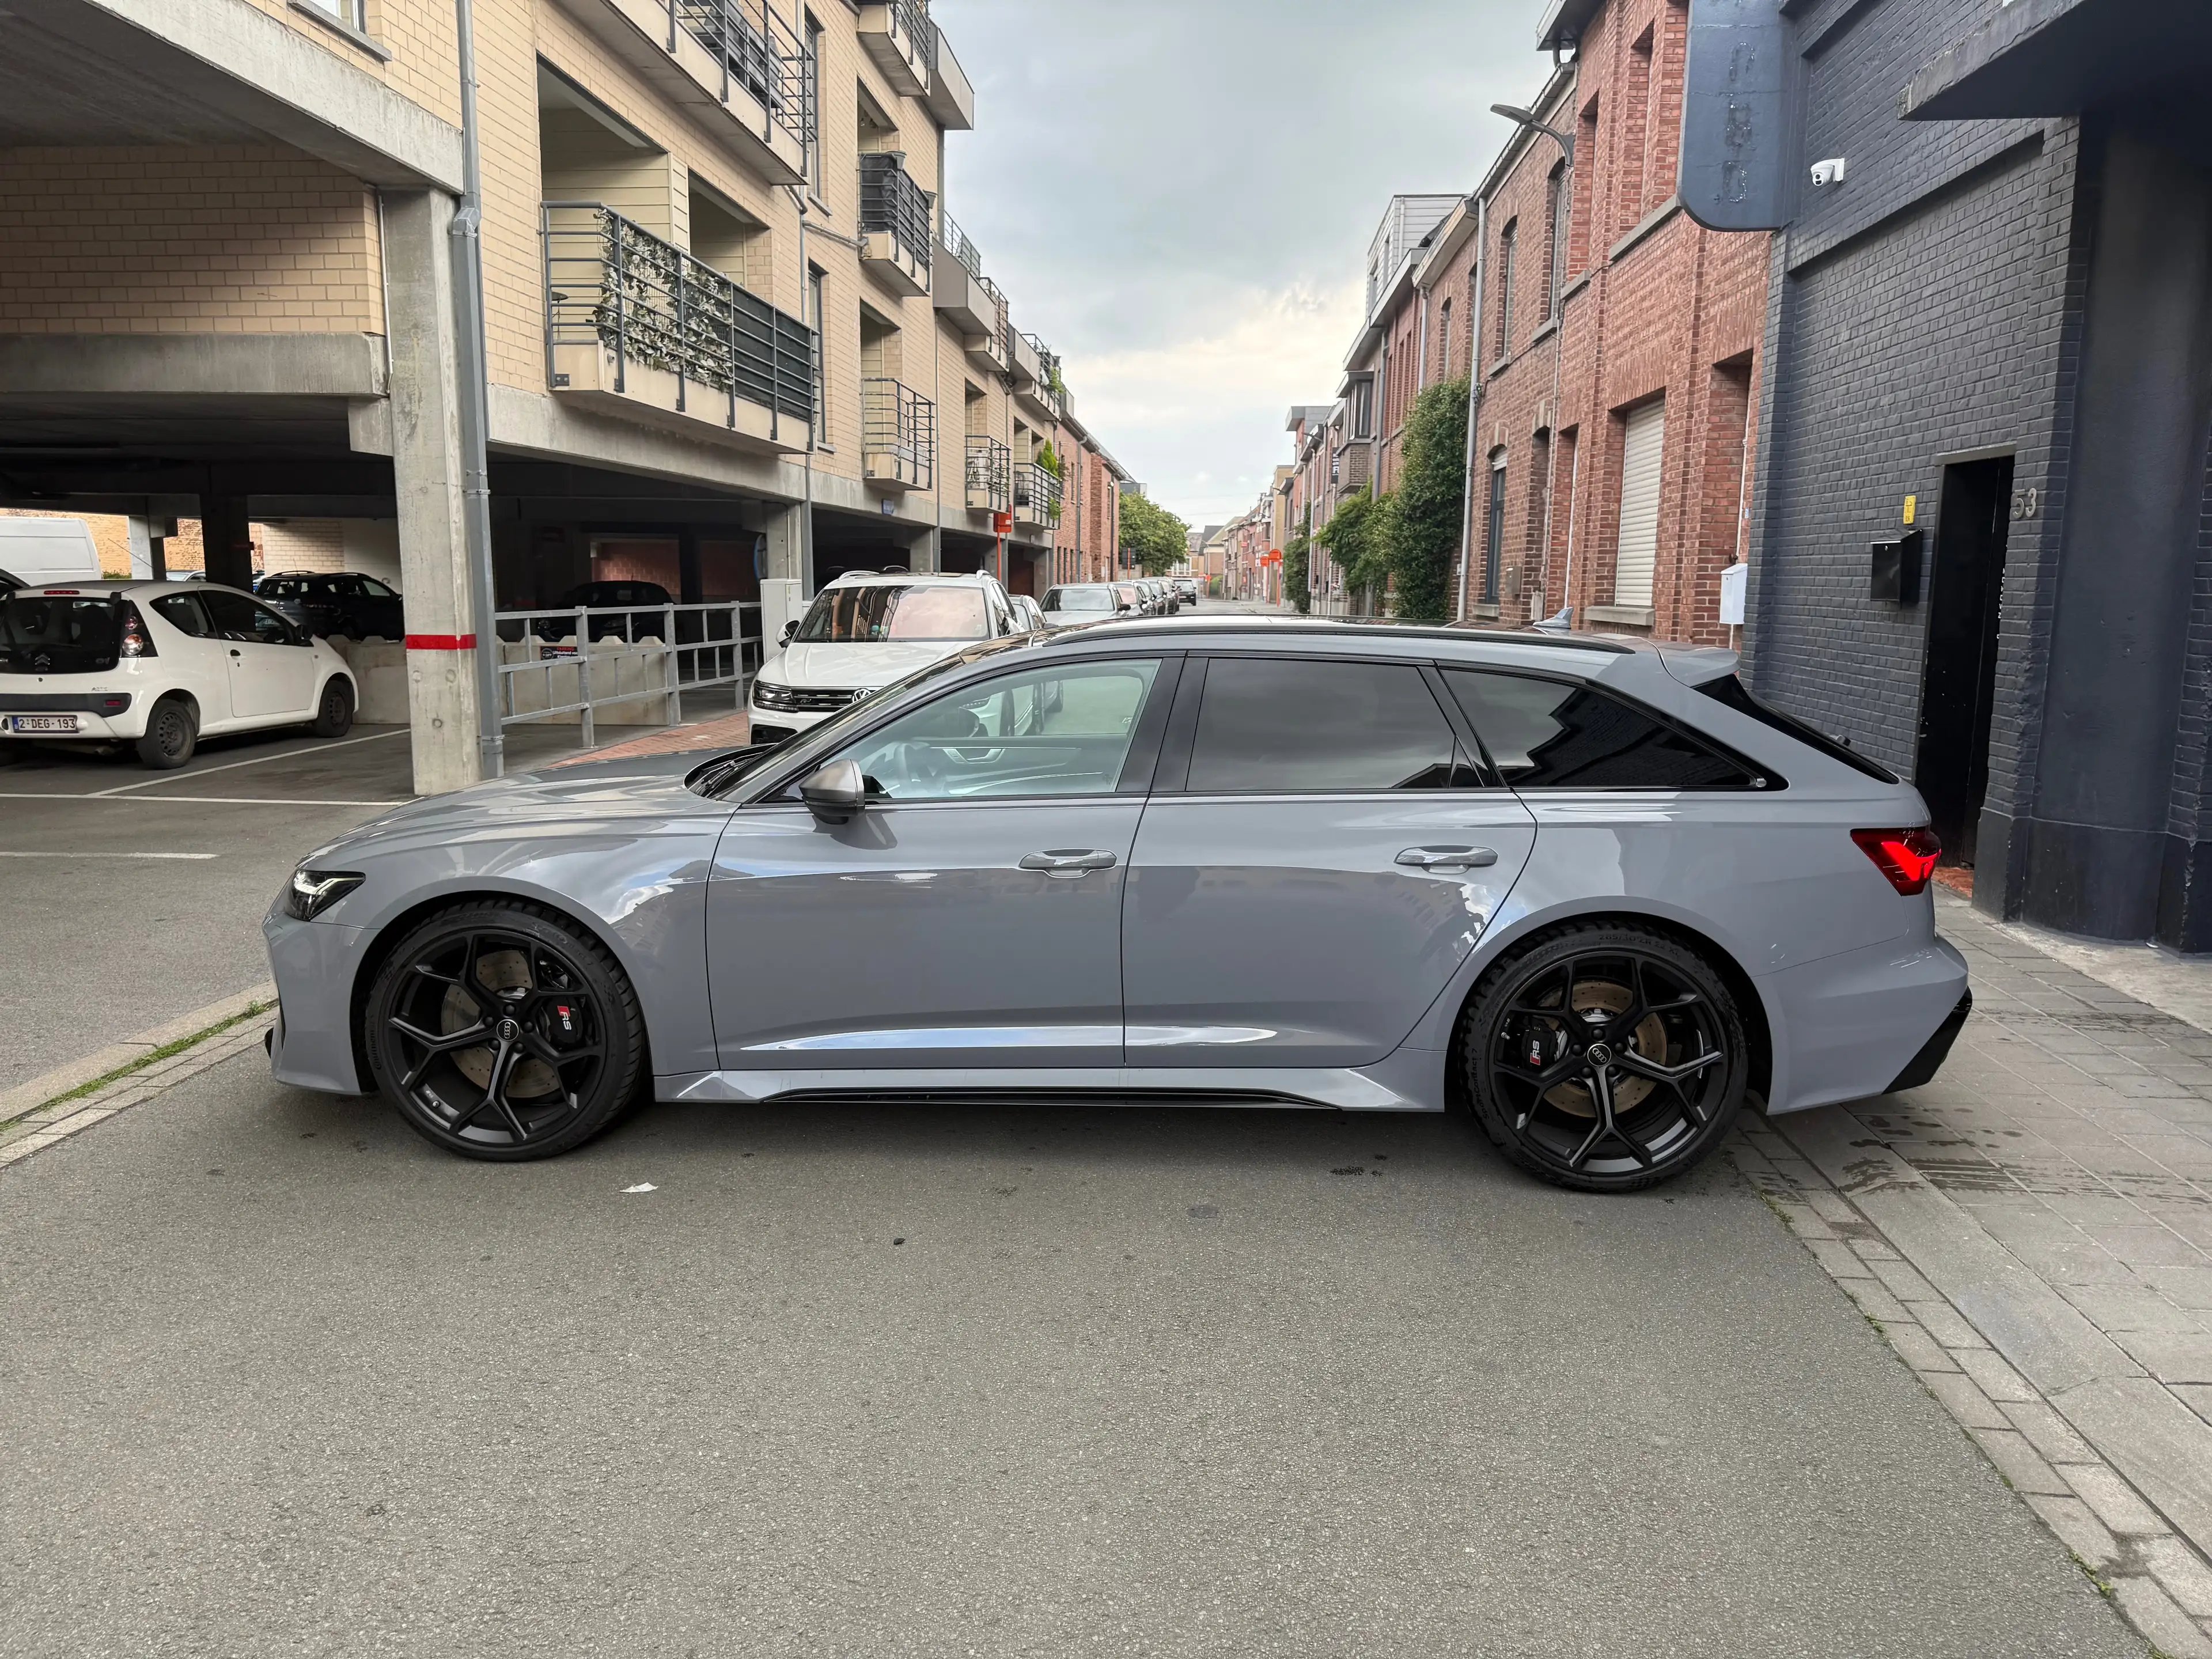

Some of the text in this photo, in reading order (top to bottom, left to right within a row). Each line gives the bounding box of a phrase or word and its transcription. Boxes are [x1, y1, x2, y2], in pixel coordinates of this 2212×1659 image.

[2013, 487, 2037, 518] 53
[18, 718, 75, 729] 2-DEG-193
[560, 1011, 572, 1031] RS
[1532, 1040, 1540, 1060] RS
